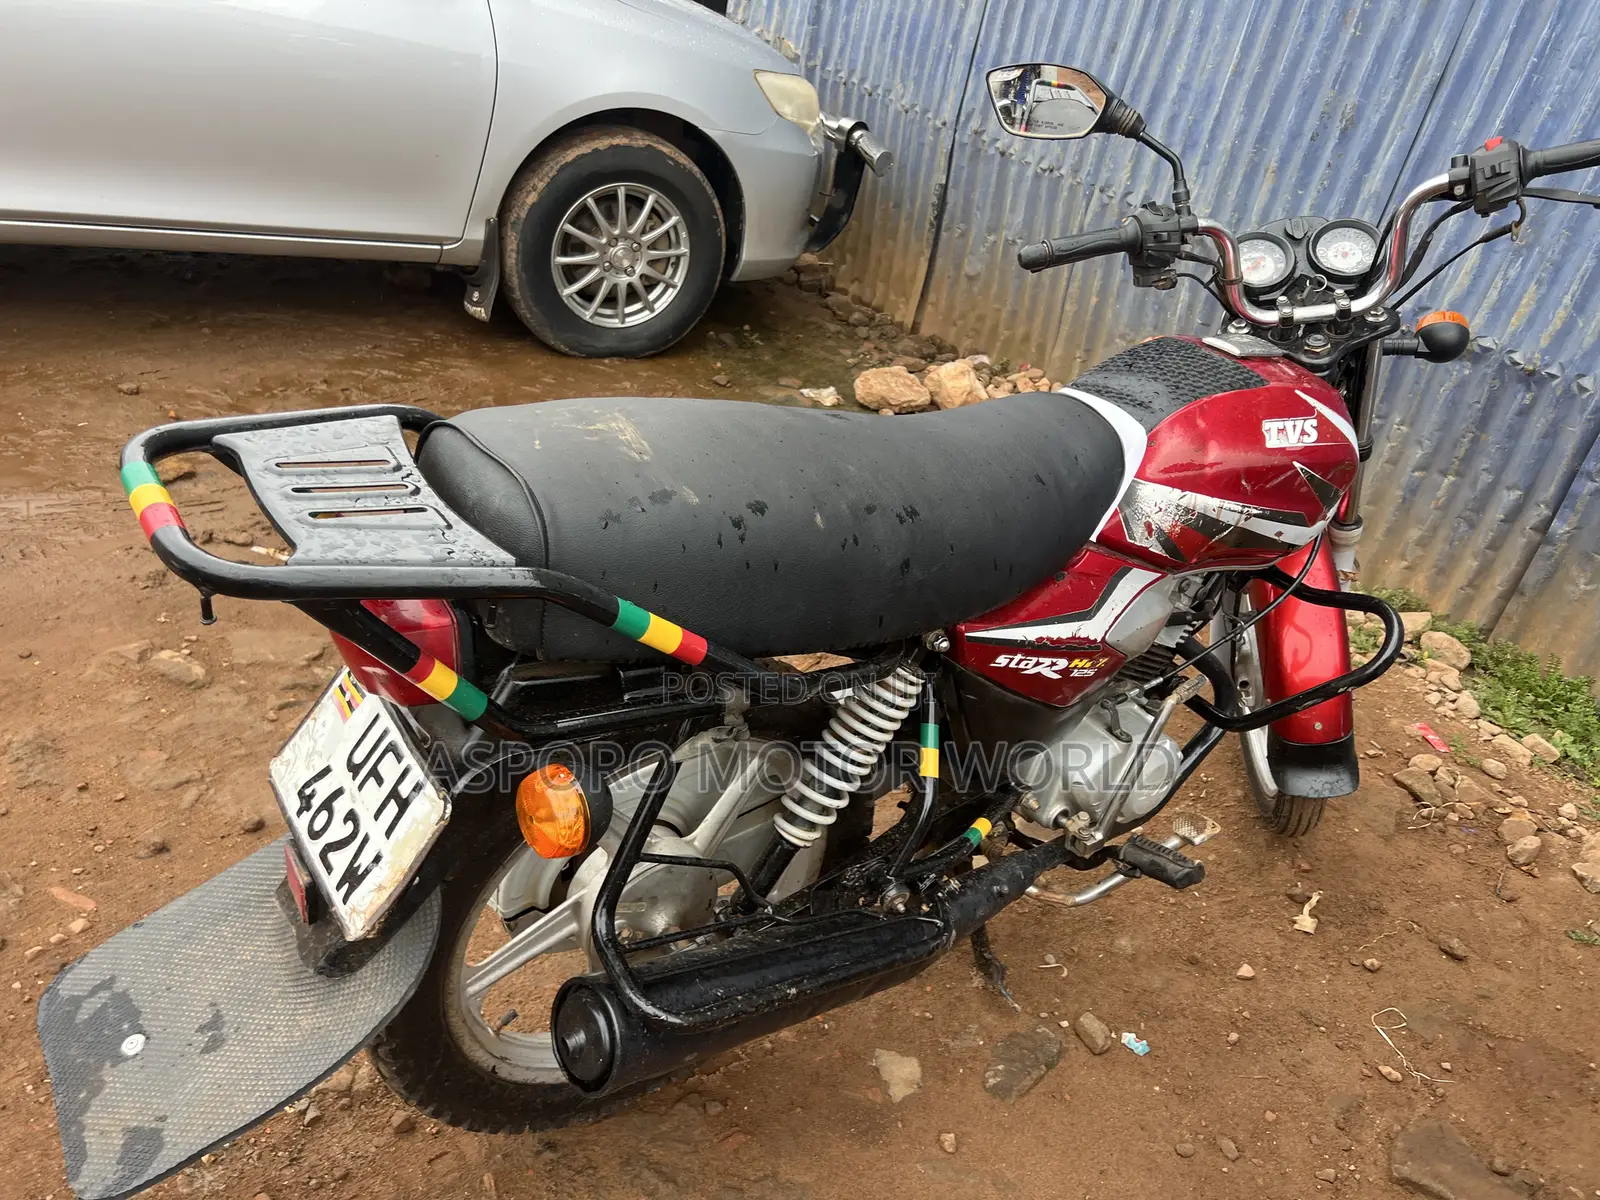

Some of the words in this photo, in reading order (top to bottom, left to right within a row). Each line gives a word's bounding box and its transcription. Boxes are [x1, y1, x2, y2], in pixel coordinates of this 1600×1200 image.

[1264, 418, 1318, 445] TVS
[1069, 668, 1098, 677] 125
[346, 712, 424, 840] UFH
[296, 764, 384, 905] 462W
